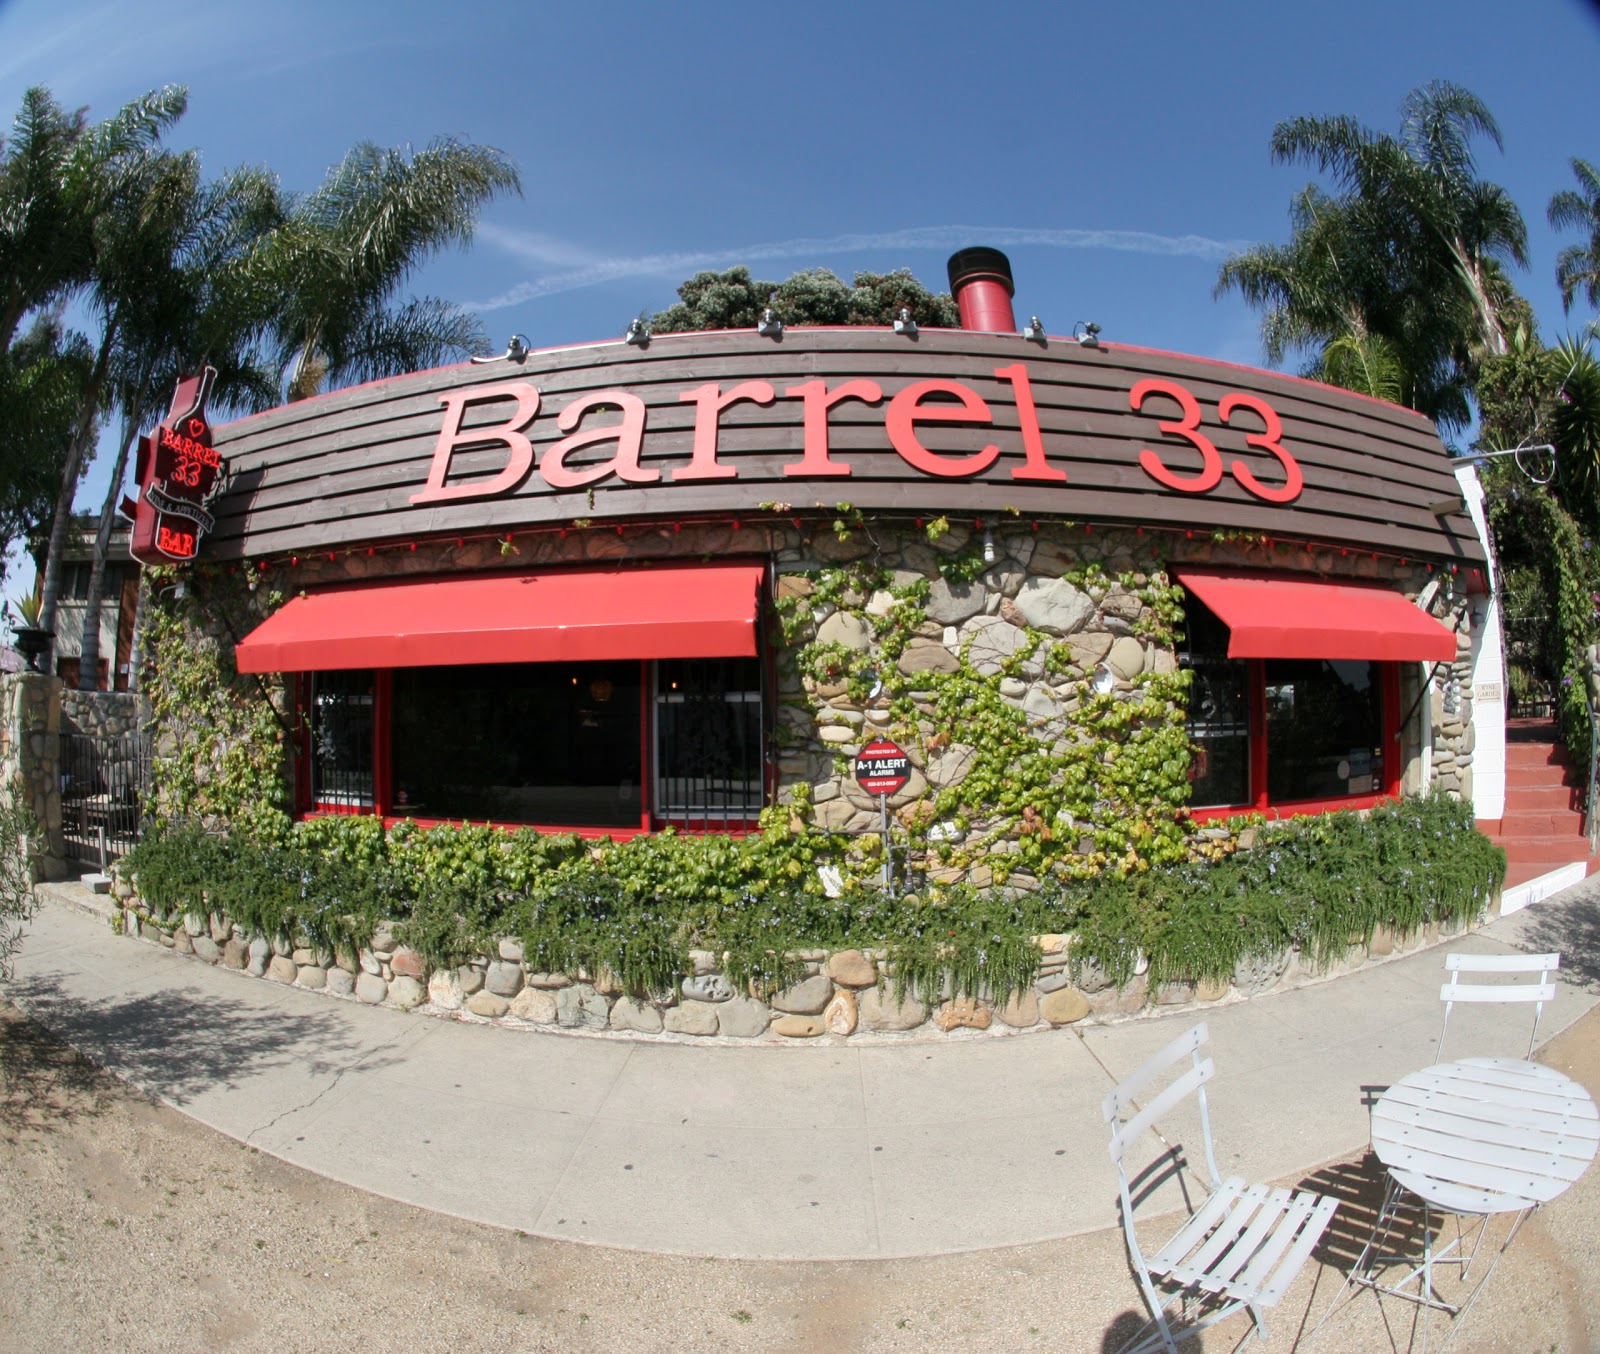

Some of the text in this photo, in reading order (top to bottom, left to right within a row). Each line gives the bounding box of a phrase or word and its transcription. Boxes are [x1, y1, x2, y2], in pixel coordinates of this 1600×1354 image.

[408, 363, 1304, 503] Barrel 33
[163, 428, 222, 468] BARREL
[174, 455, 202, 487] 33
[148, 493, 165, 510] WINE
[159, 527, 194, 556] BAR
[857, 759, 907, 770] A-1 ALERT
[869, 769, 895, 777] ALARMS
